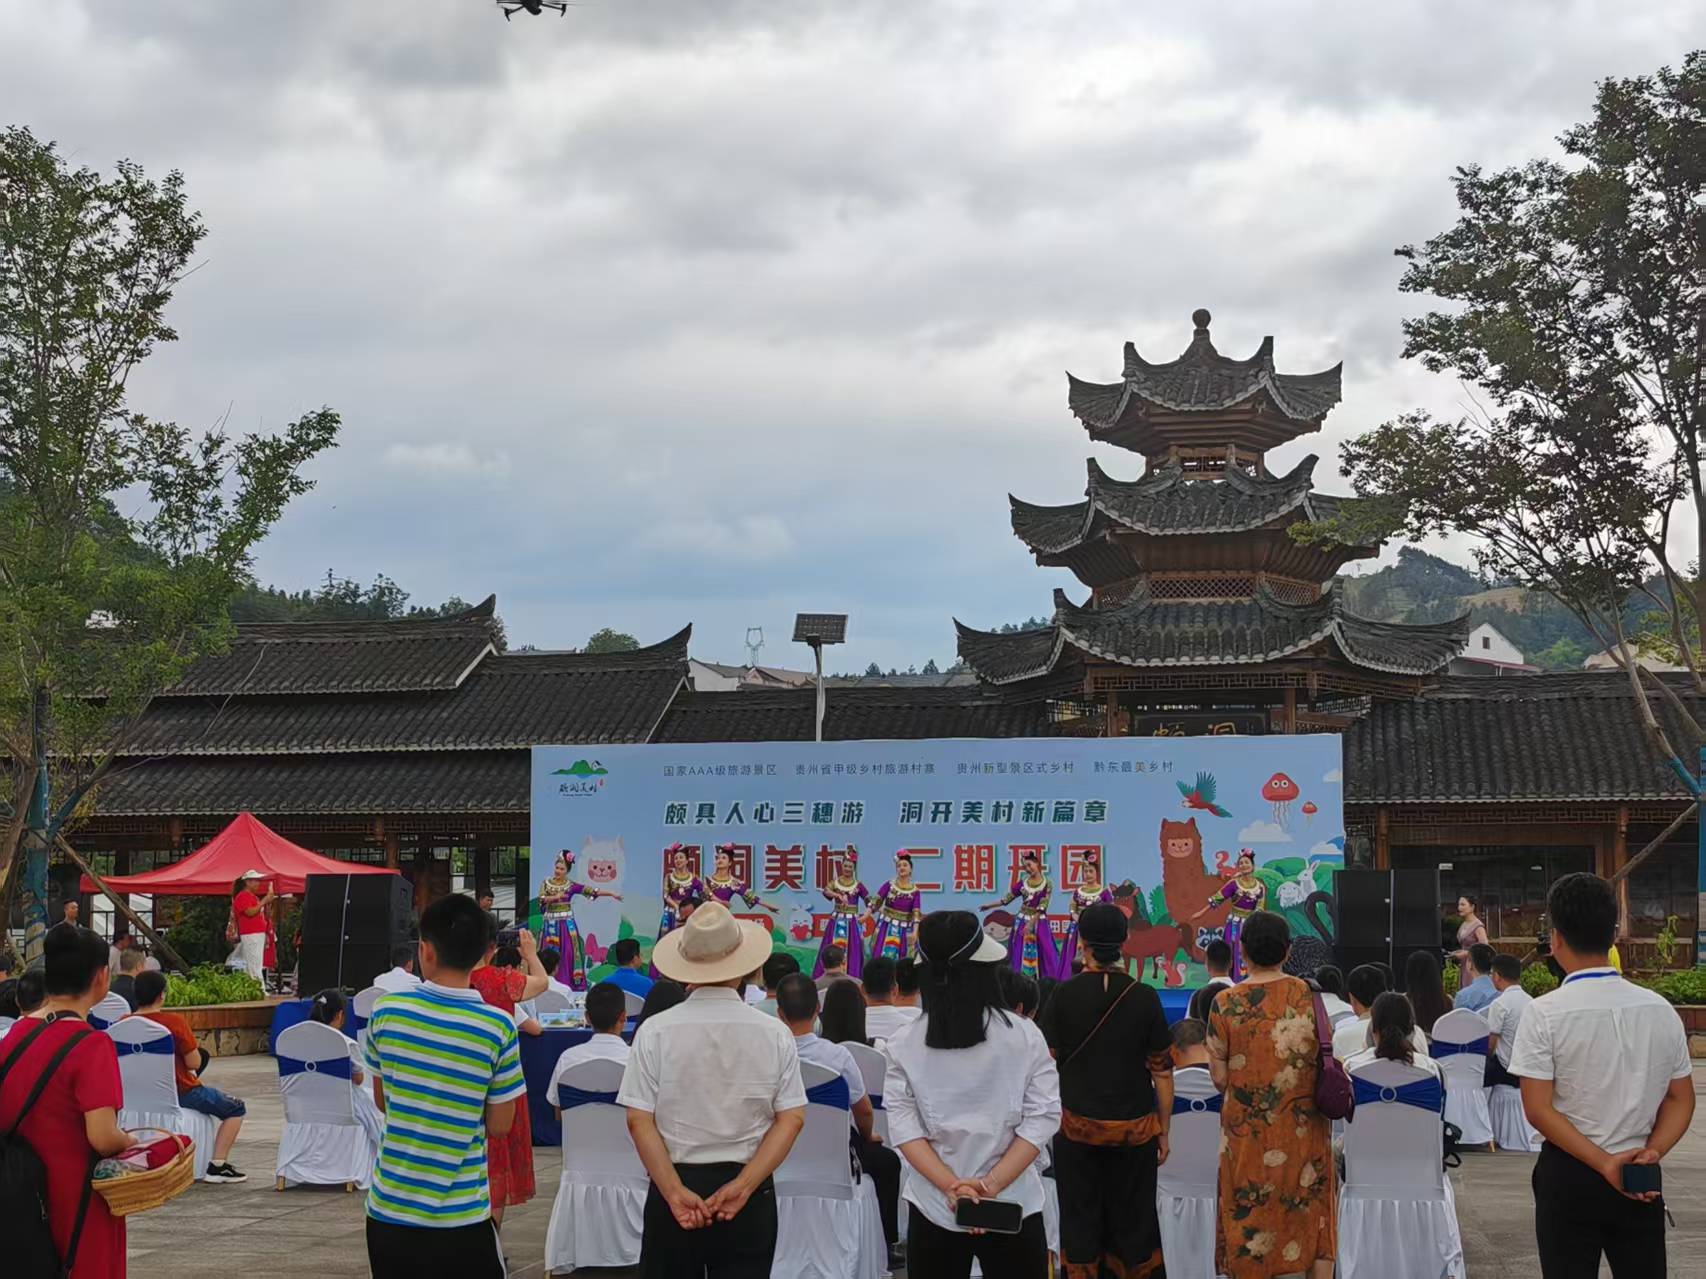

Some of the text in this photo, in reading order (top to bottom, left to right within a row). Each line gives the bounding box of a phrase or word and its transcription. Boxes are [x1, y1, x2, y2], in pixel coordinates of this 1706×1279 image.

[664, 764, 777, 777] 国家AAA级旅游景区
[1094, 760, 1173, 773] 黔东最美乡村
[664, 800, 1108, 825] 颇具人心三穗游 洞开美村新篇章
